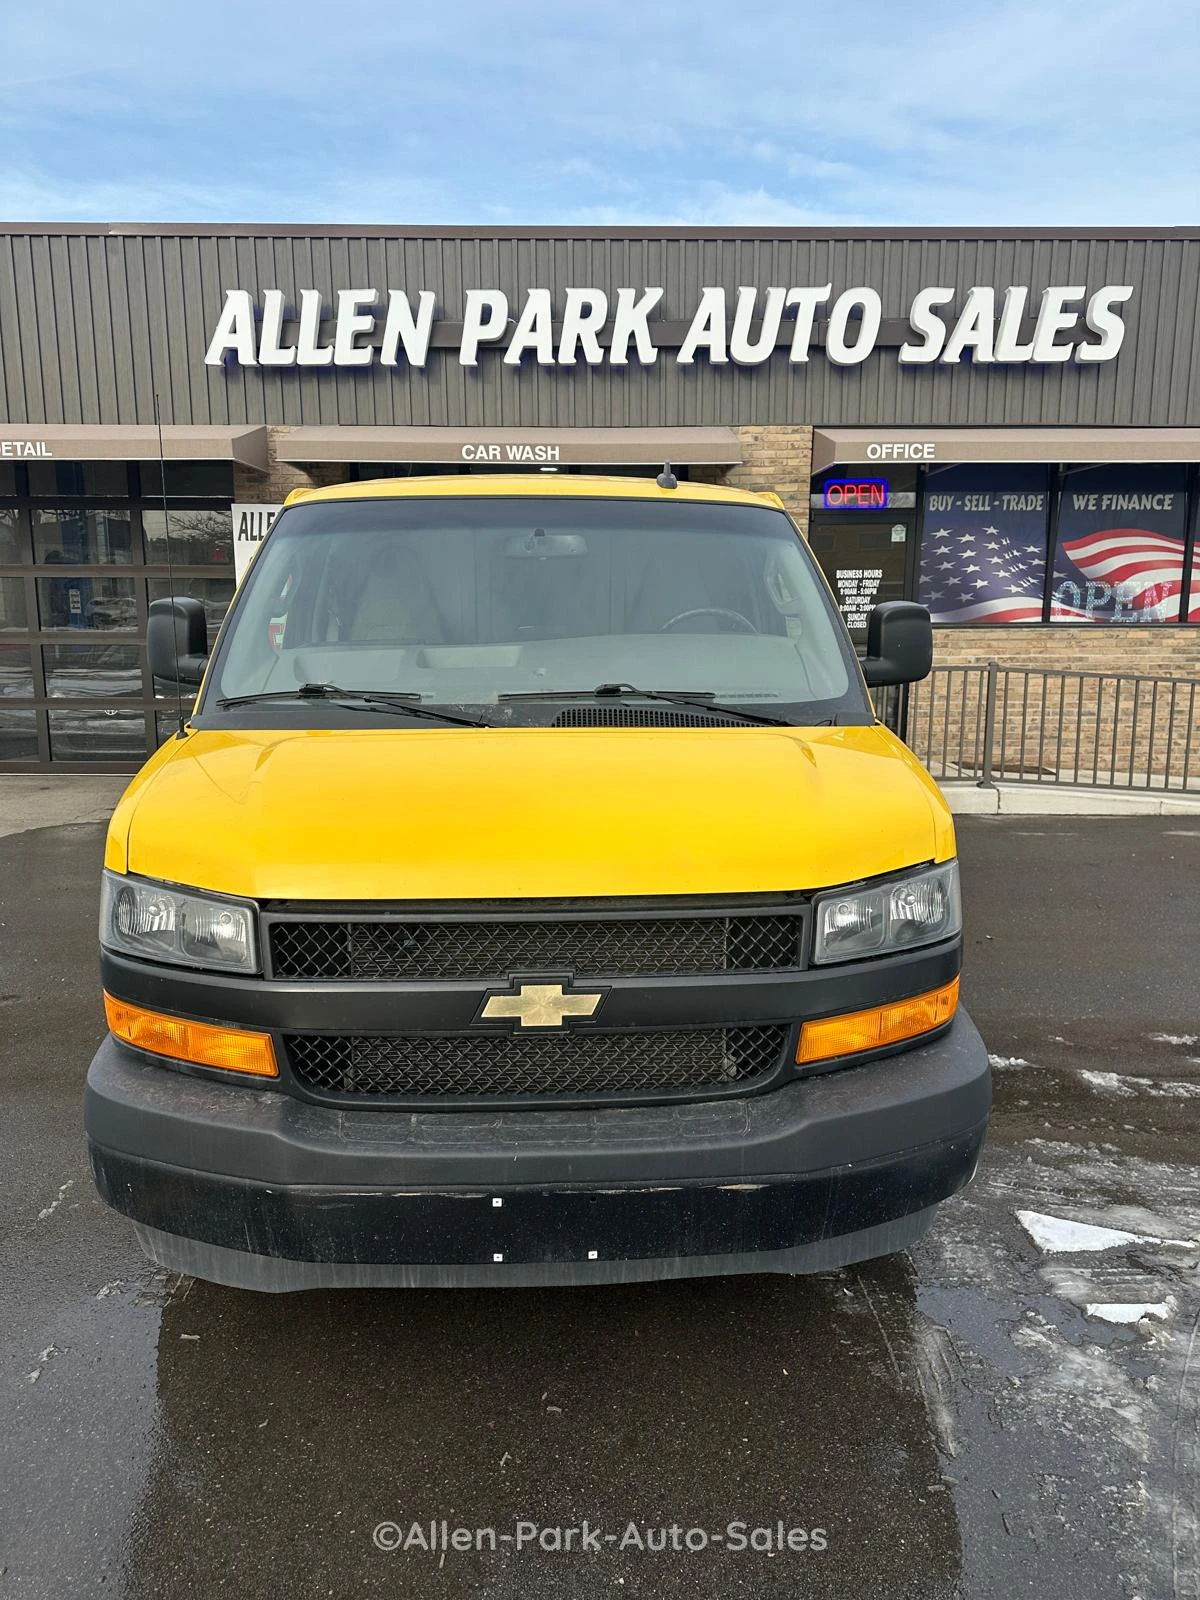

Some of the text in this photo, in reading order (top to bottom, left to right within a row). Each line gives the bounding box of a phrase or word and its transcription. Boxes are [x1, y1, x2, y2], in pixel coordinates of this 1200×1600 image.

[204, 283, 1134, 367] ALLEN PARK AUTO SALES
[0, 441, 53, 456] ETAIL
[461, 444, 560, 461] CAR WASH
[866, 443, 936, 459] OFFICE
[827, 484, 885, 505] OPEN
[929, 495, 952, 511] BUY
[964, 494, 990, 511] SELL
[1001, 494, 1043, 511] TRADE
[1072, 494, 1174, 510] WE FINANCE
[238, 511, 280, 541] ALLE
[836, 569, 883, 578] BUSINESS HOURS
[837, 579, 858, 588] MONDAY
[862, 579, 881, 588] FRIDAY
[845, 596, 871, 604] SATURDAY
[847, 612, 868, 621] SUNDAY
